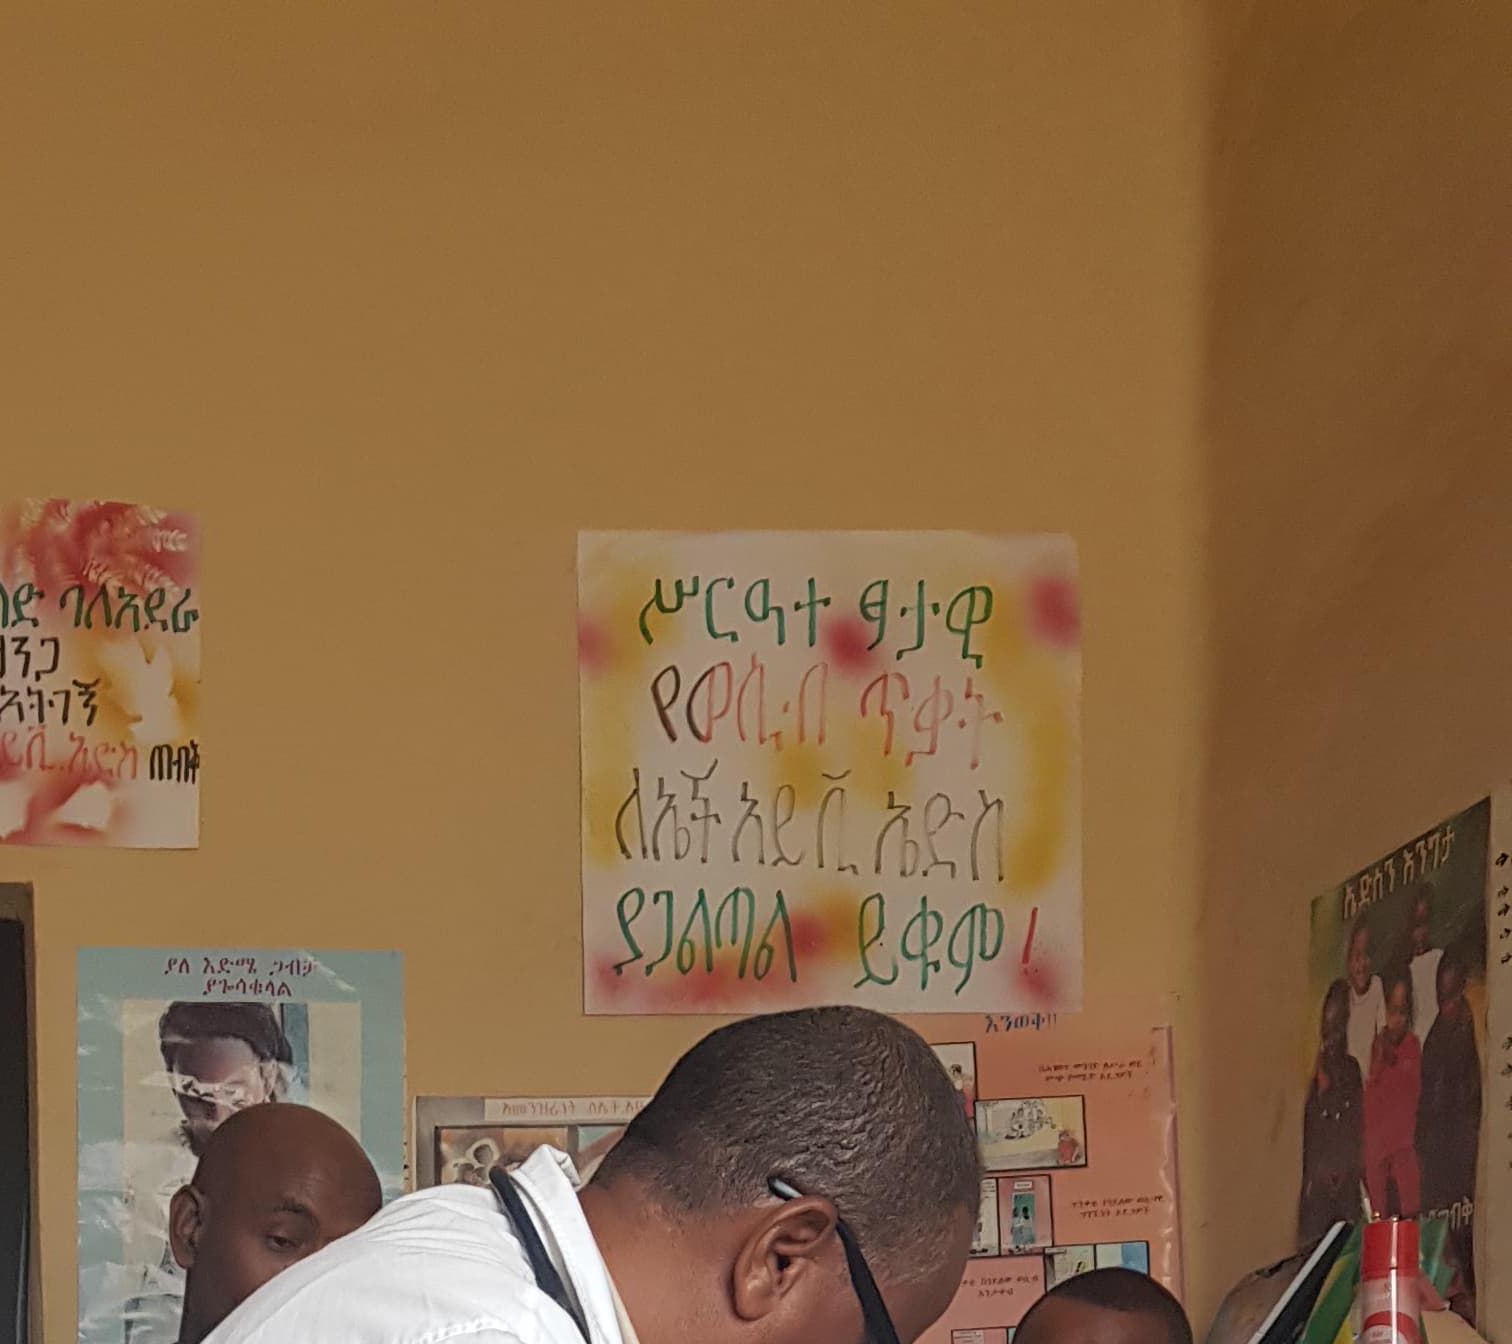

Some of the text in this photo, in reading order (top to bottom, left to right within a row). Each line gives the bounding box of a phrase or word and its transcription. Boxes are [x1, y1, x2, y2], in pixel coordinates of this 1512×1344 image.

[861, 672, 1003, 770] ጥቃት
[164, 957, 315, 976] ያለ እድሜ ጋብቻ
